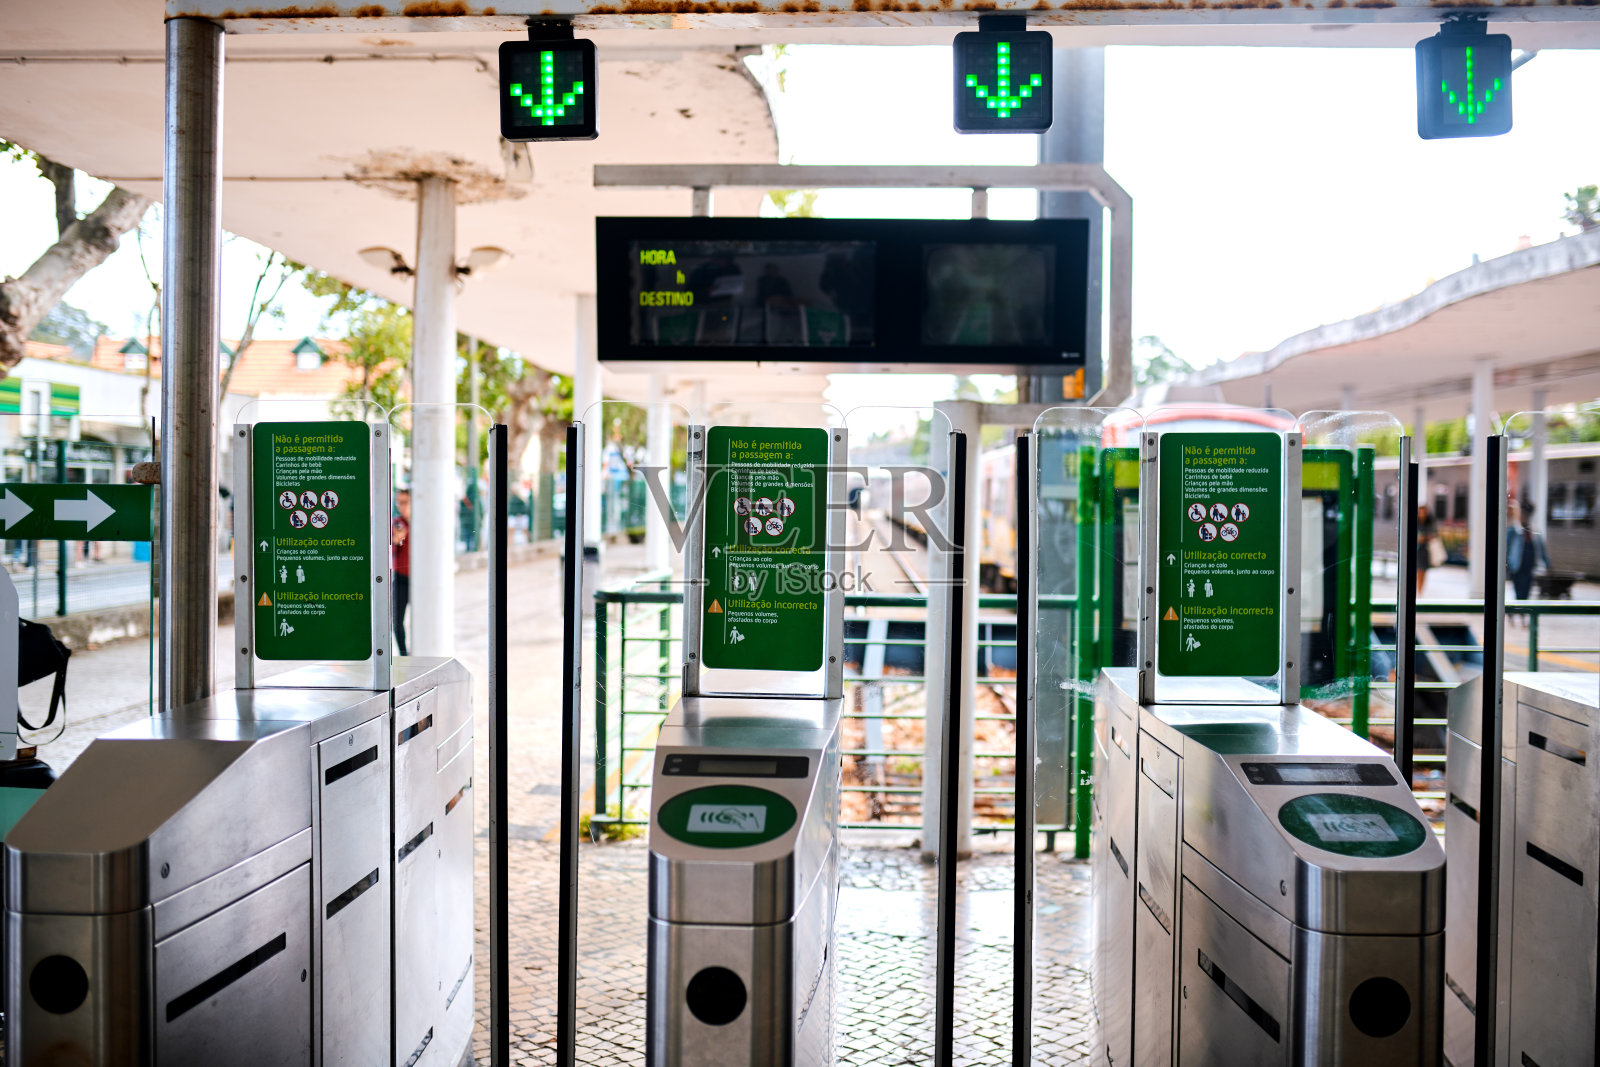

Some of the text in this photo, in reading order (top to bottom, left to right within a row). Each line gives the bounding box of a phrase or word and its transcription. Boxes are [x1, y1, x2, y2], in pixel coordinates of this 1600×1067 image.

[640, 250, 676, 265] HORA
[677, 270, 685, 285] h
[640, 291, 694, 306] DESTINO
[275, 435, 343, 444] Não é permitida
[283, 446, 325, 454] passagem
[732, 440, 801, 450] Não é permitida
[1185, 446, 1255, 455] Não é permitida
[740, 452, 782, 460] passagem
[1193, 458, 1236, 466] passagem
[277, 538, 355, 547] Utilização correcta
[1184, 551, 1228, 561] Utilização
[277, 592, 363, 602] Utilização incorrecta
[728, 600, 817, 610] Utilização incorrecta
[1184, 606, 1273, 616] Utilização incorrecta
